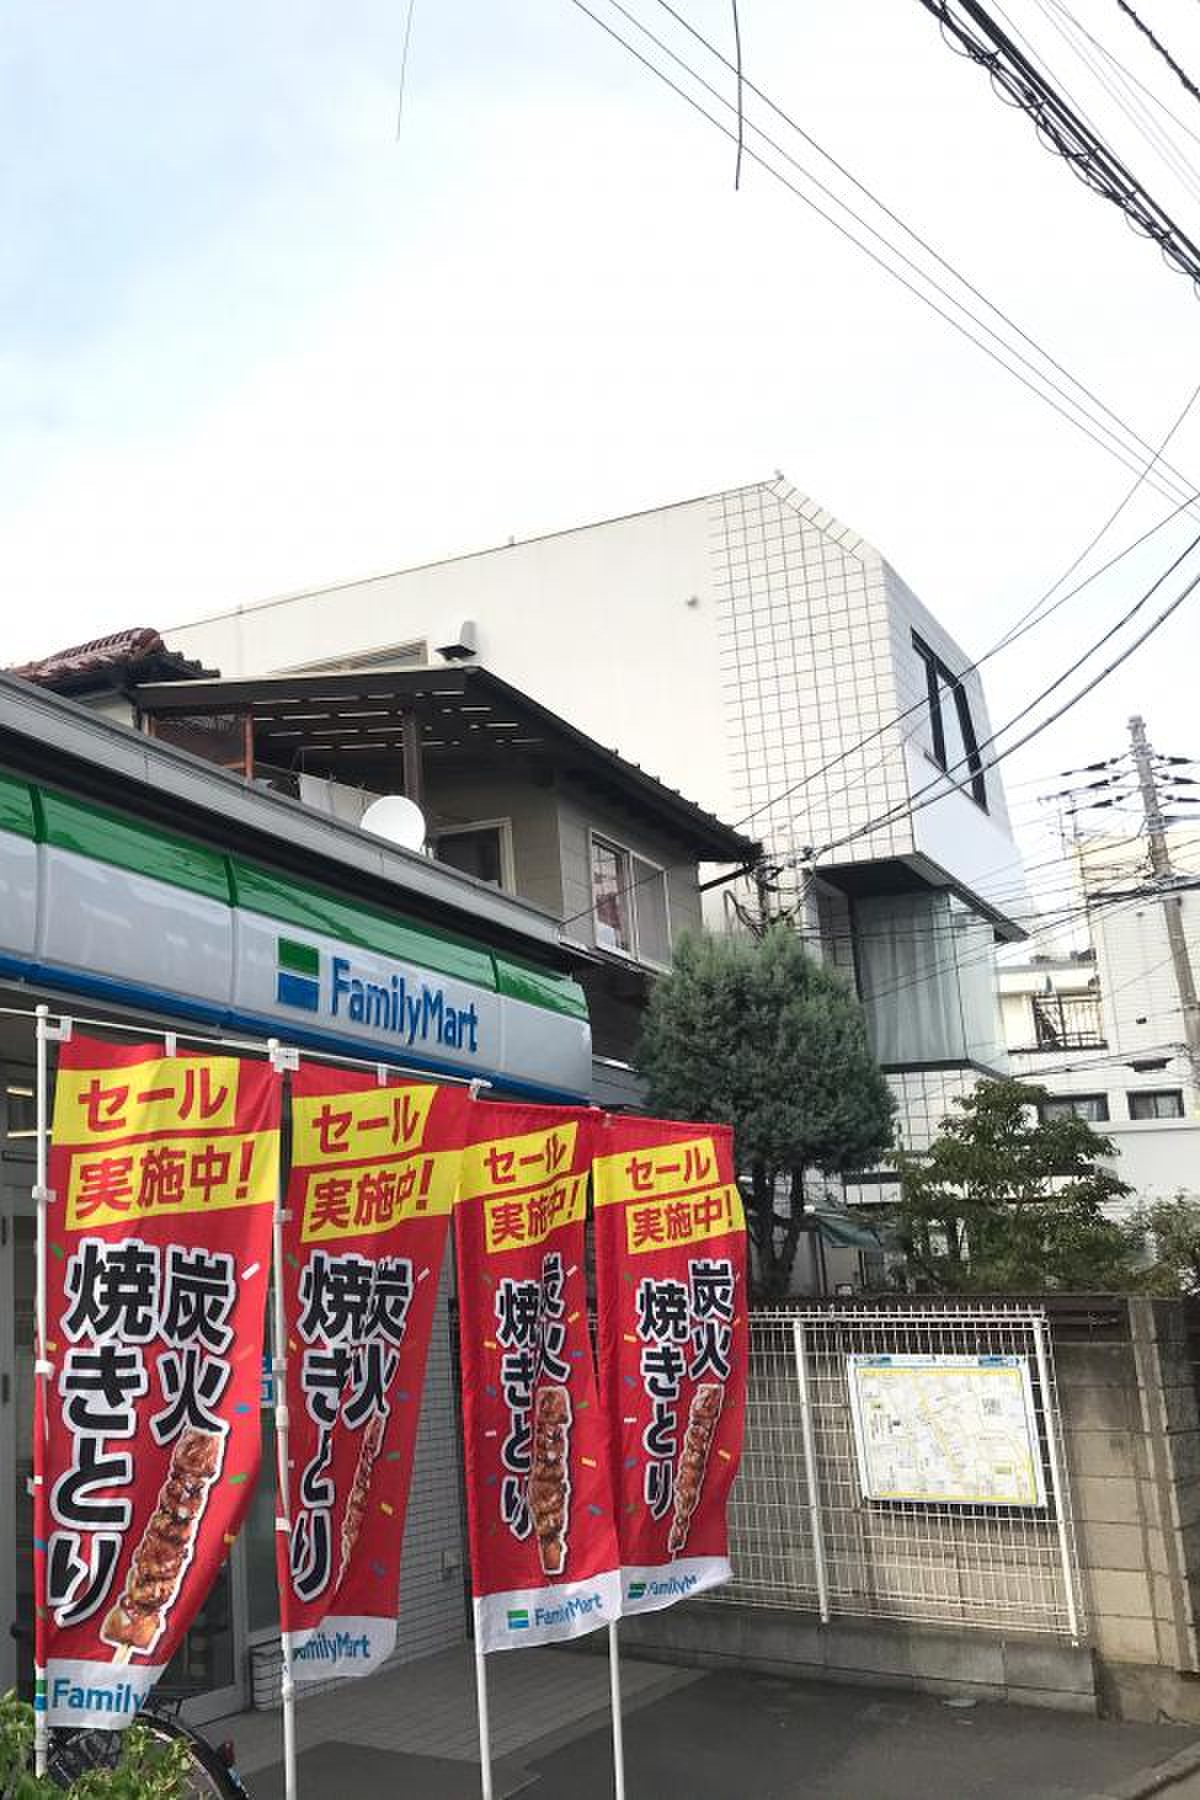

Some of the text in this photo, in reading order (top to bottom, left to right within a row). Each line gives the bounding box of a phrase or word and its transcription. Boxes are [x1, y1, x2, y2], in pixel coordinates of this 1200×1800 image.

[331, 956, 479, 1053] FamilyMart
[78, 1067, 228, 1132] セール
[312, 1095, 420, 1153] セール
[75, 1140, 255, 1220] 実施中!
[483, 1133, 568, 1184] セール
[625, 1146, 711, 1191] セール
[632, 1189, 733, 1246] 実施中!
[150, 1244, 235, 1447] 炭火
[687, 1259, 732, 1380] 炭火
[48, 1240, 162, 1628] 焼きとり
[636, 1278, 691, 1521] 焼きとり
